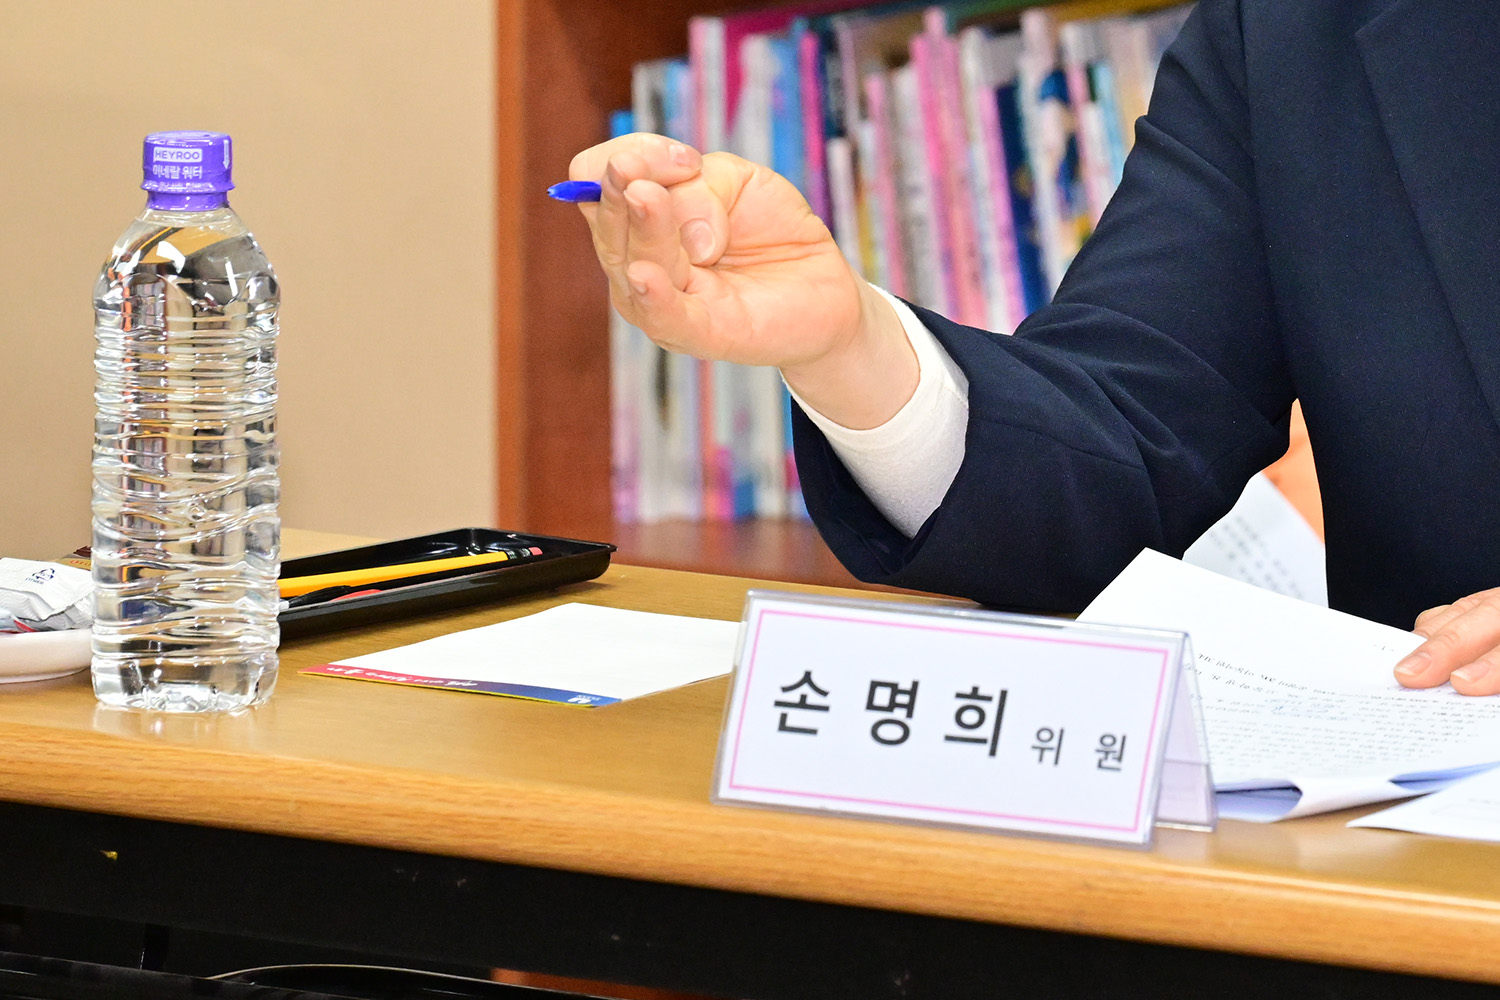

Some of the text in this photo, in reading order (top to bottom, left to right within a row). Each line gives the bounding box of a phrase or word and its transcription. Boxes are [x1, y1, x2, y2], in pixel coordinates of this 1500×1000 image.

[155, 151, 199, 159] HEYROO
[153, 164, 202, 179] 미네랄 워터
